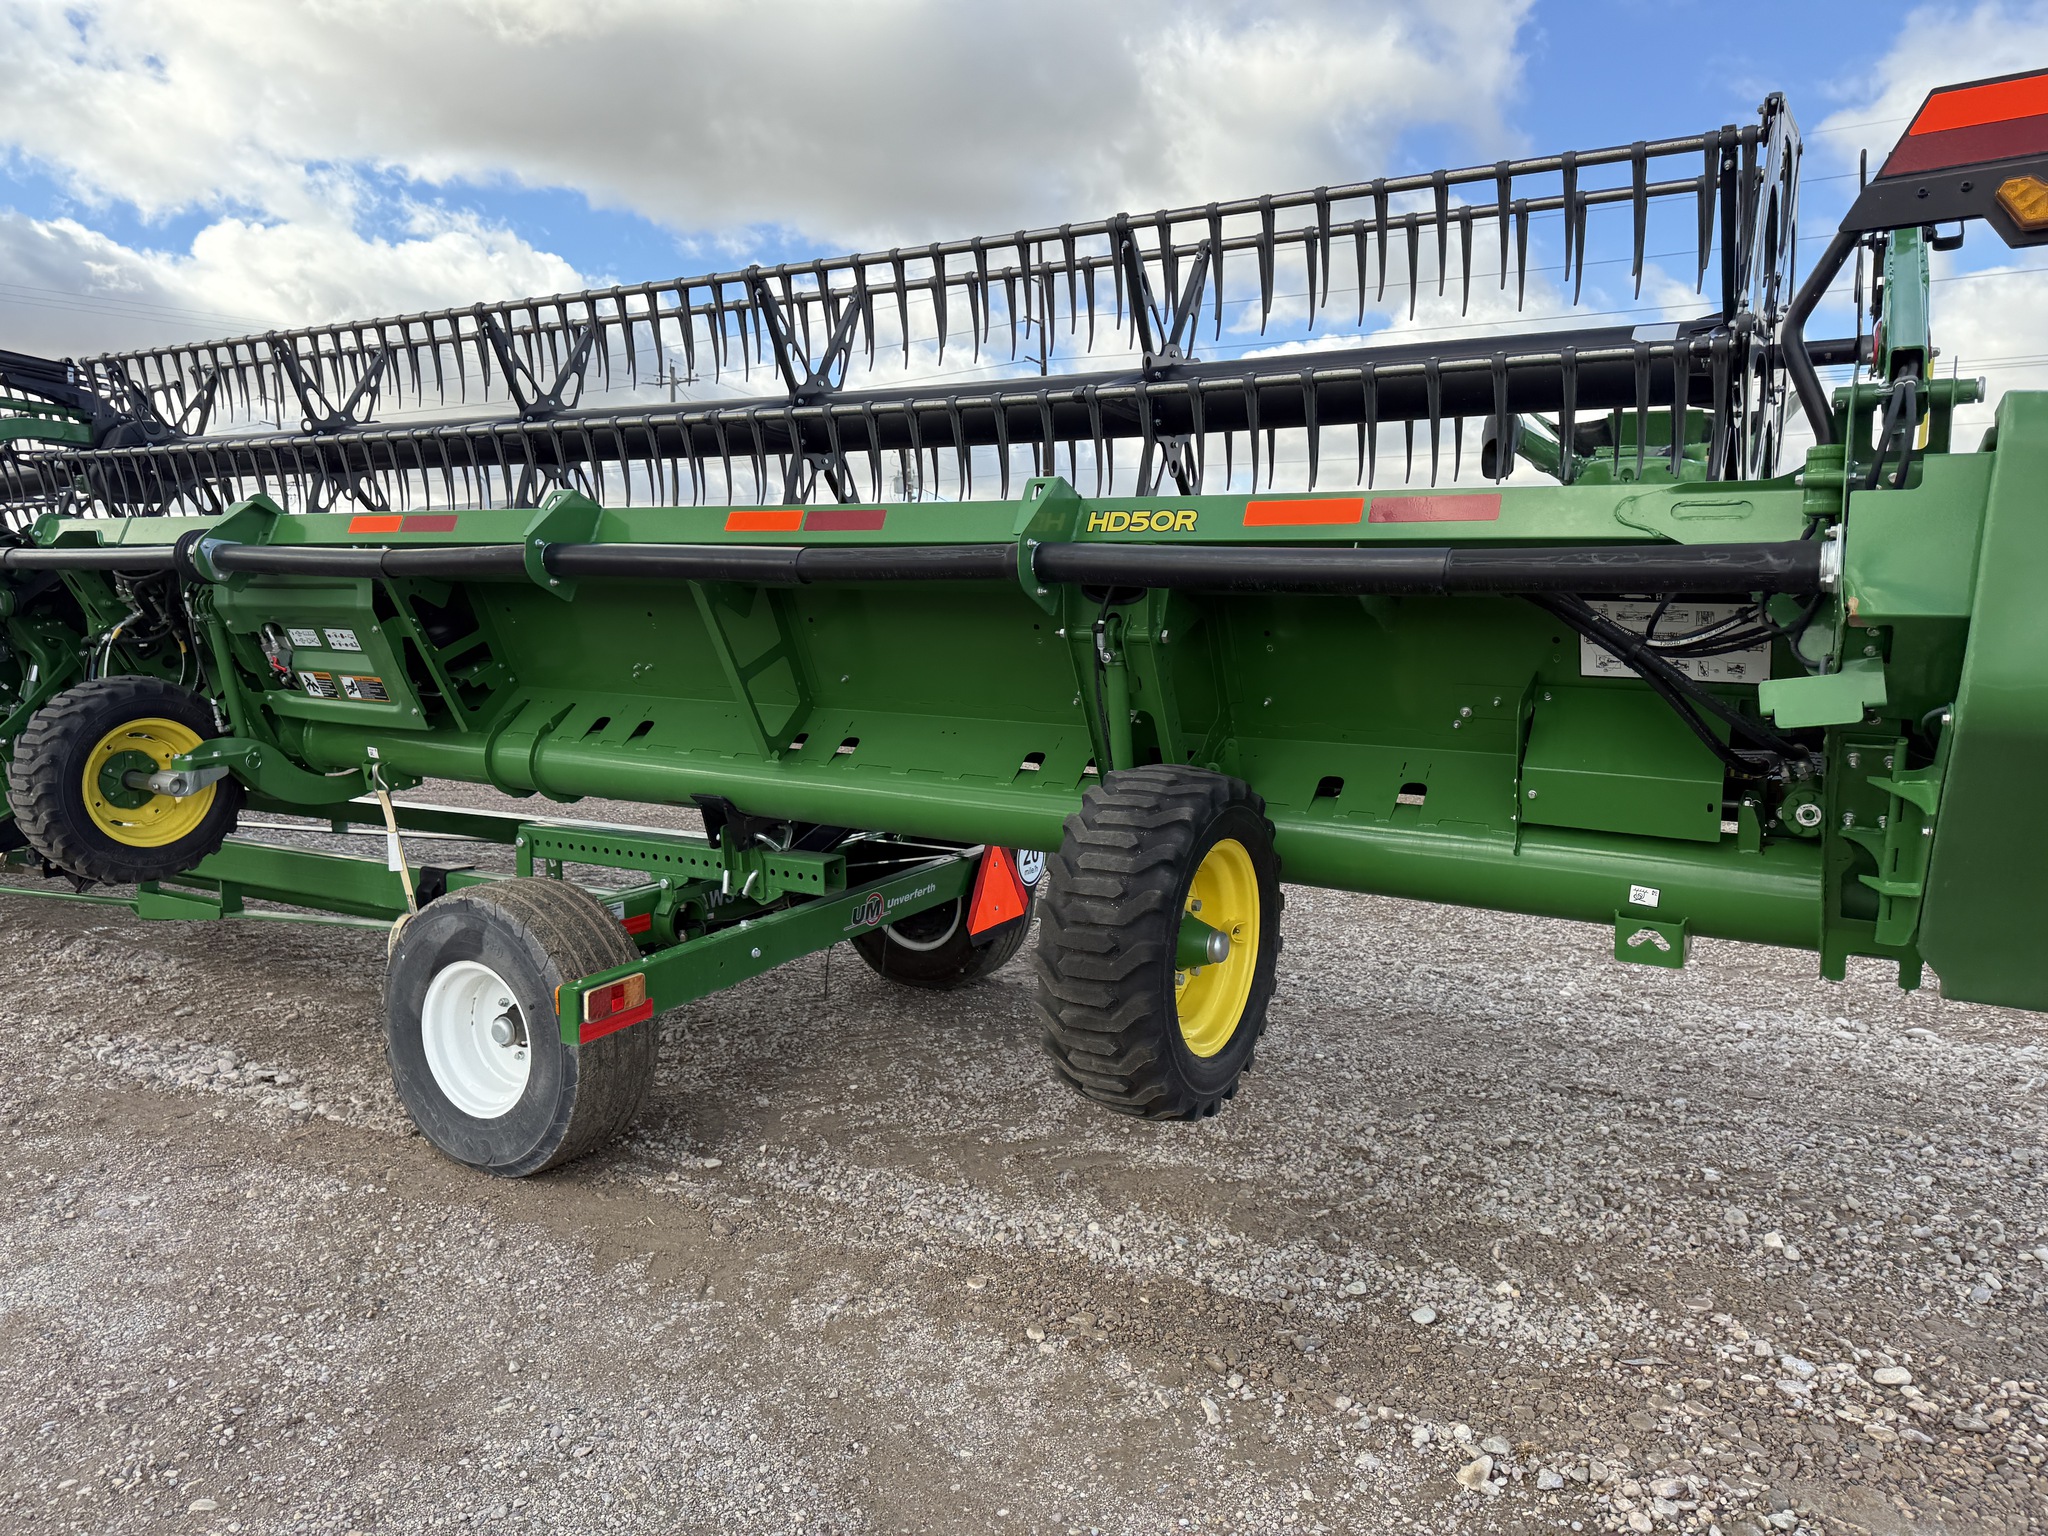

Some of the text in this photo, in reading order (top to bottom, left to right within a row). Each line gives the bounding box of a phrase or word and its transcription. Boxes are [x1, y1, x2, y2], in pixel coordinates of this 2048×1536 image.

[1086, 510, 1198, 532] HD50R
[852, 883, 936, 926] UM Unverferth
